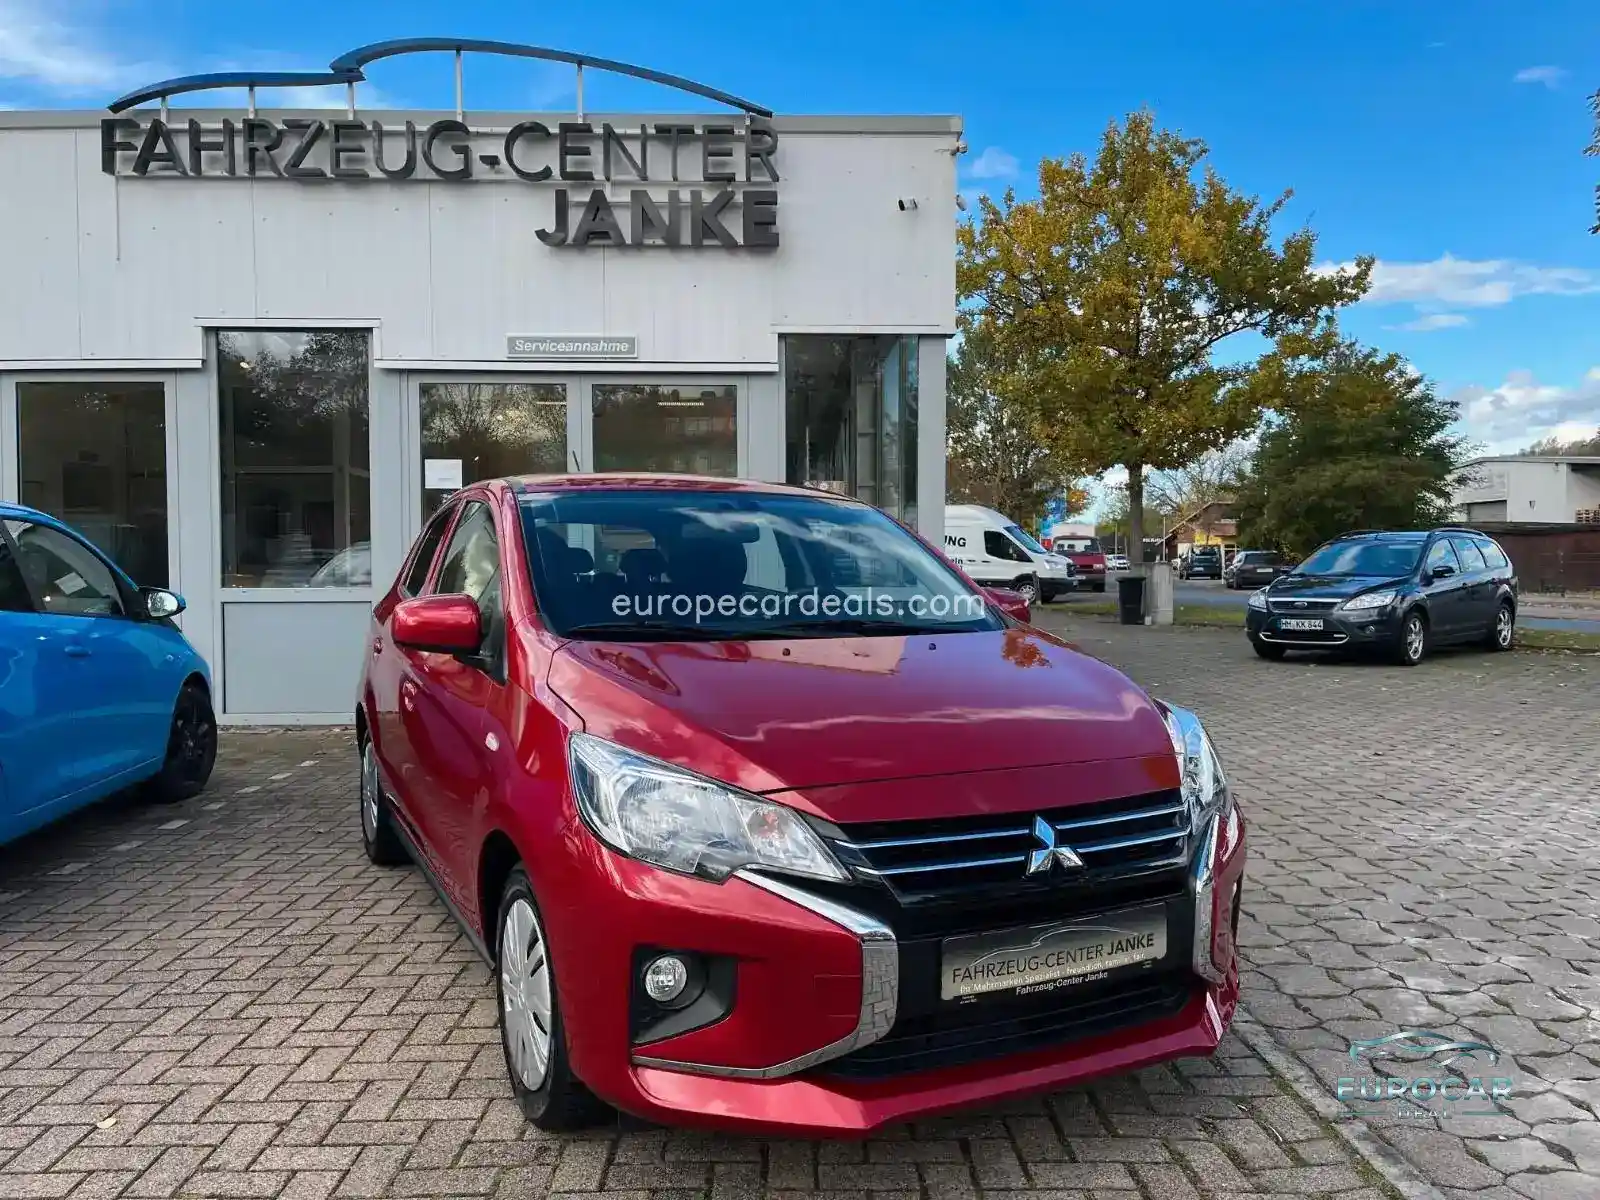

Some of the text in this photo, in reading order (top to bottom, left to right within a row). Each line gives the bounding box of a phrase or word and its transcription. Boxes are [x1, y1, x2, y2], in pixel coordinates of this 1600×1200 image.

[101, 118, 780, 183] FAHRZEUG-CENTER
[535, 188, 780, 248] JANKE
[514, 339, 629, 353] Serviceannahme
[952, 932, 1155, 984] FAHRZEUG-CENTER JANKE
[1024, 969, 1061, 985] Spezialist
[1015, 971, 1108, 996] Fahrzeug-Center Janke
